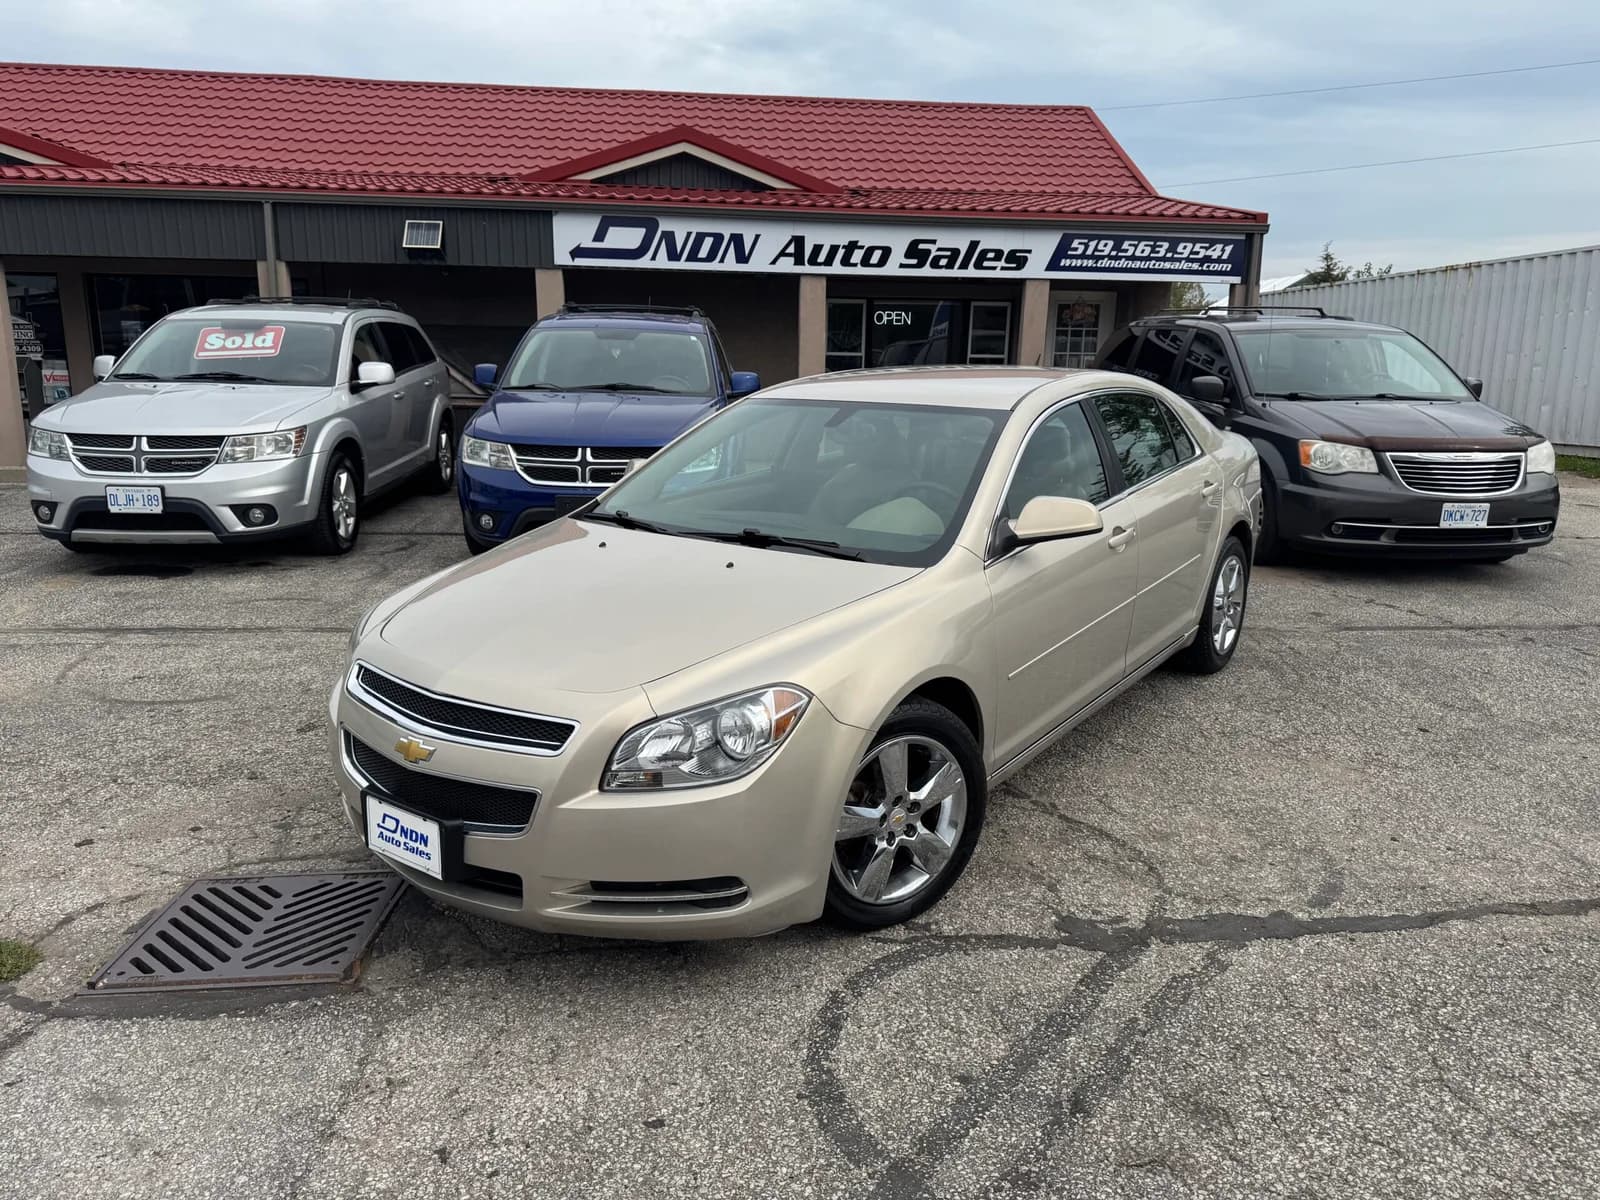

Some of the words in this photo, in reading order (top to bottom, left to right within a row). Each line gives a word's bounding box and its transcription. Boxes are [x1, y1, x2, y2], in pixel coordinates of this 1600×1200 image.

[569, 215, 761, 264] DNDN
[769, 235, 892, 268] Auto
[899, 239, 1032, 271] Sales
[1067, 239, 1234, 260] 519.563.9541
[1060, 257, 1232, 271] www.dndnautosales.com
[873, 310, 912, 326] OPEN
[203, 331, 276, 350] Sold
[109, 493, 135, 507] DLJH
[141, 494, 160, 508] 189
[1442, 509, 1466, 522] DKCW
[1470, 509, 1488, 522] 727
[376, 812, 429, 848] DNDN
[377, 831, 401, 848] Auto
[402, 841, 432, 861] Sales
